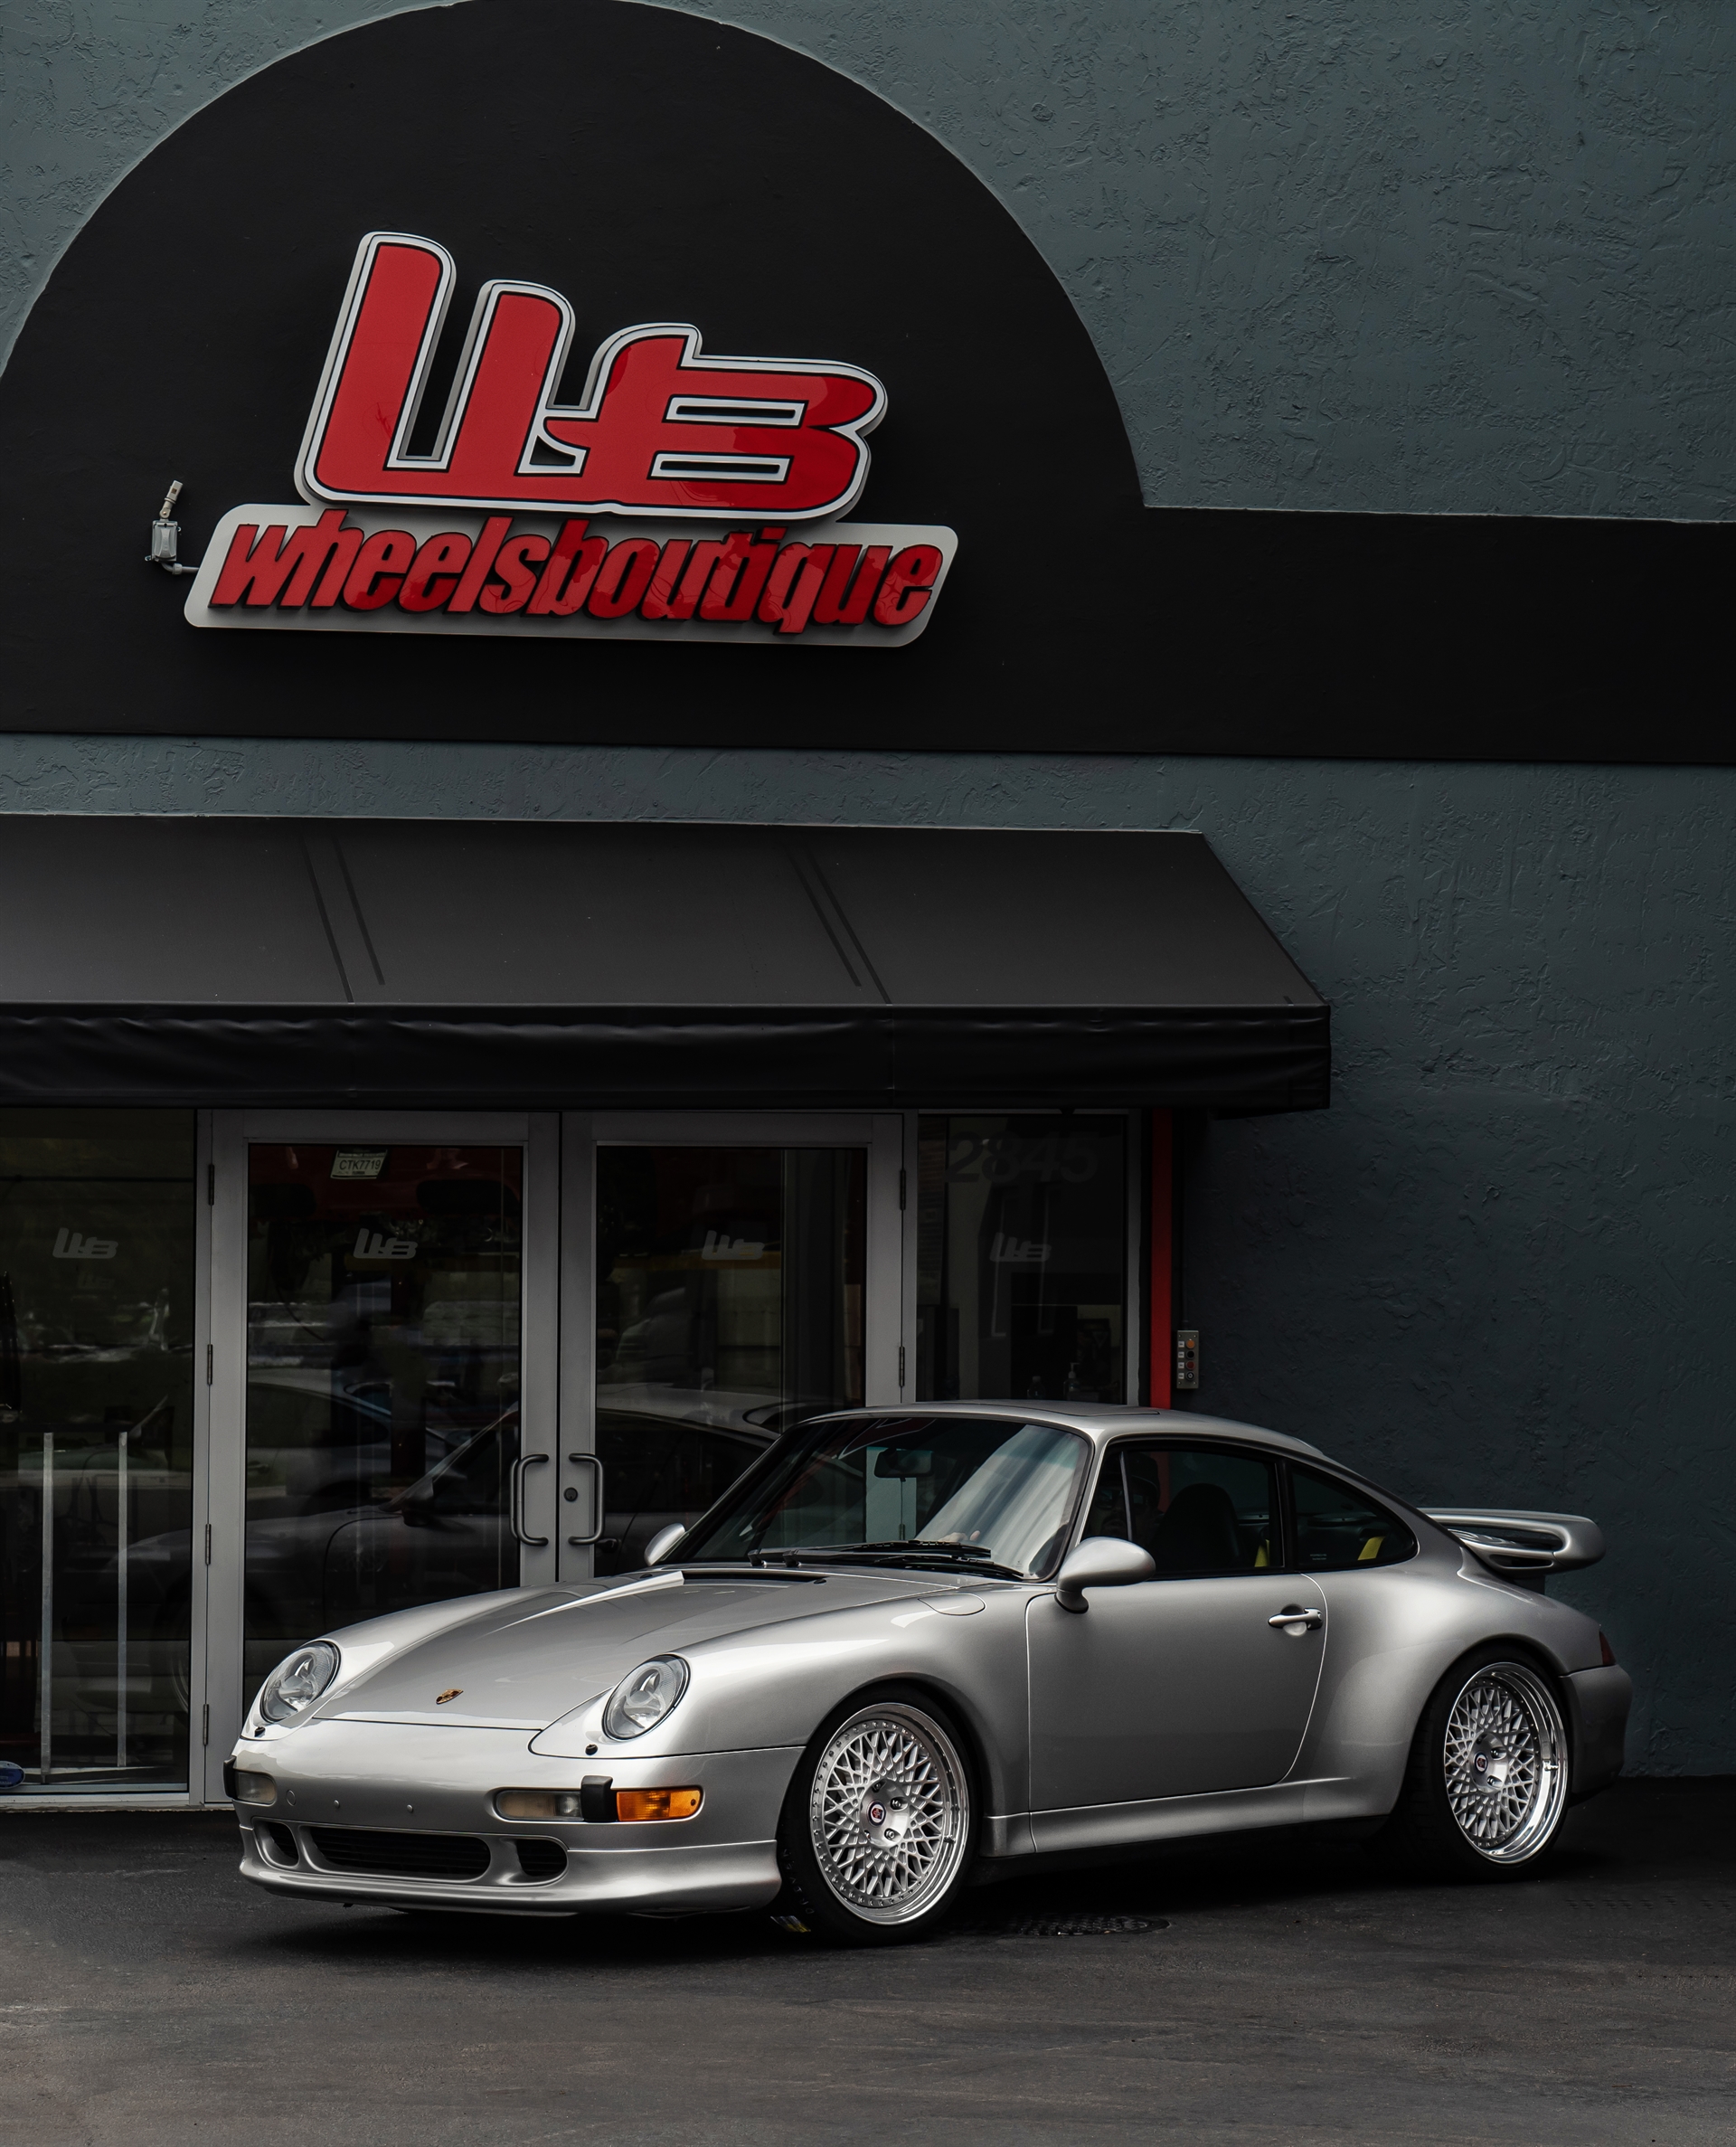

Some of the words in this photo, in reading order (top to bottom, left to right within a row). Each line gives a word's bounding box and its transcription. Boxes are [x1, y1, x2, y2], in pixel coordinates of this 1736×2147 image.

[207, 508, 945, 636] wheelsboutique
[339, 1159, 382, 1170] CTK7719
[945, 1130, 1099, 1183] 2845
